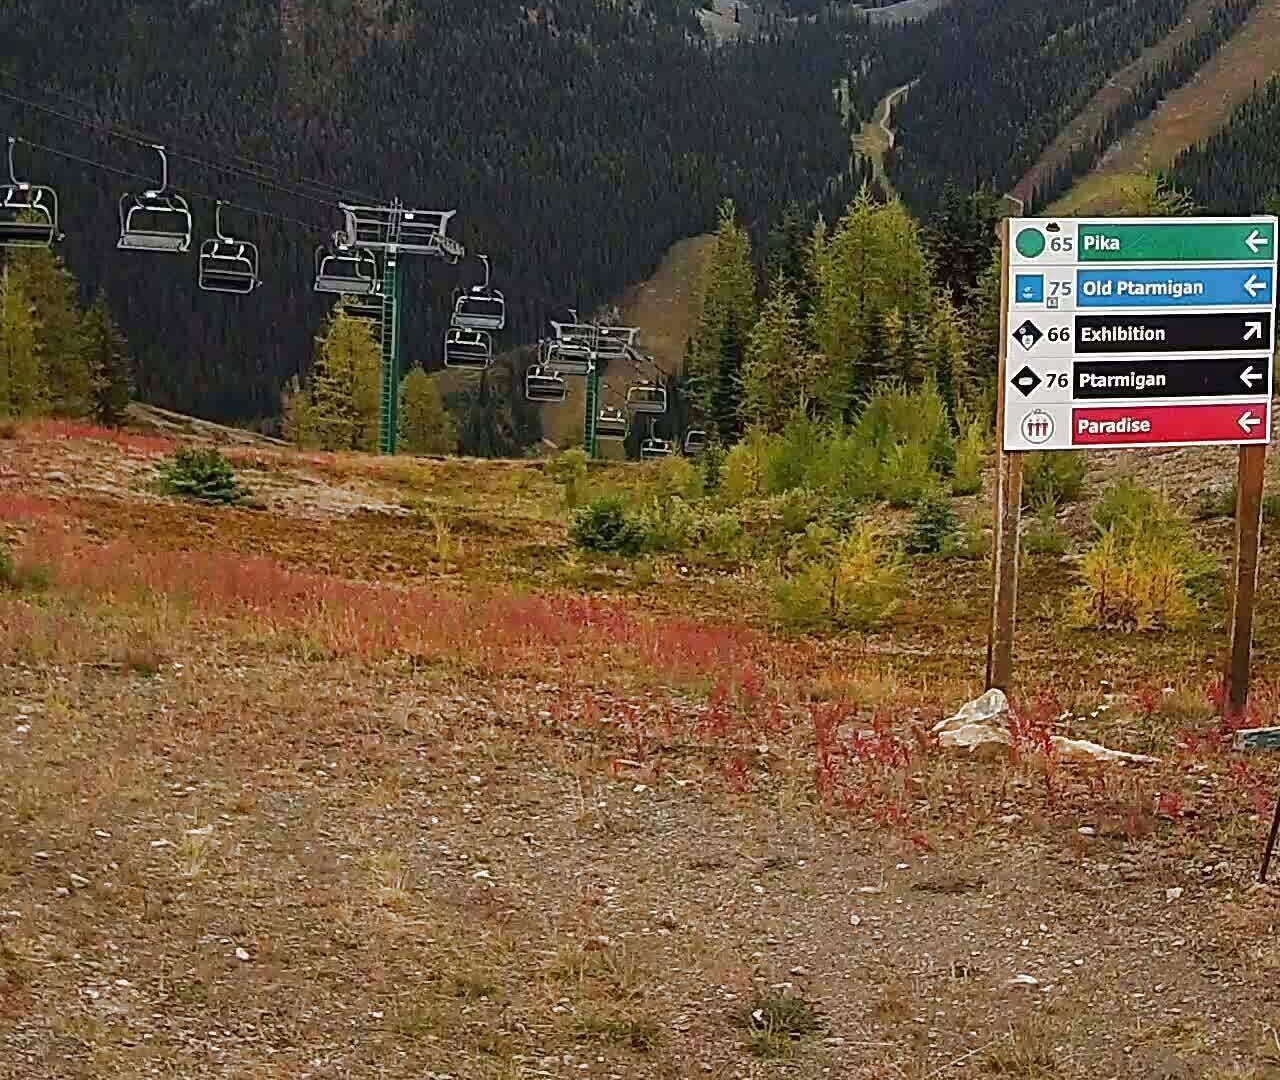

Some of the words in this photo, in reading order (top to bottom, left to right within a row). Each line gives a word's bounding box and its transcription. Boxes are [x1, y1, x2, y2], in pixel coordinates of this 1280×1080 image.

[1050, 237, 1073, 252] 65
[1083, 235, 1120, 251] Pika
[1048, 281, 1072, 297] 75
[1083, 280, 1112, 296] Old
[1117, 279, 1203, 298] Ptarmigan
[1047, 327, 1070, 342] 66
[1081, 325, 1166, 342] Exhibition
[1046, 373, 1069, 388] 76
[1079, 372, 1166, 390] Ptarmigan
[1078, 418, 1151, 434] Paradise
